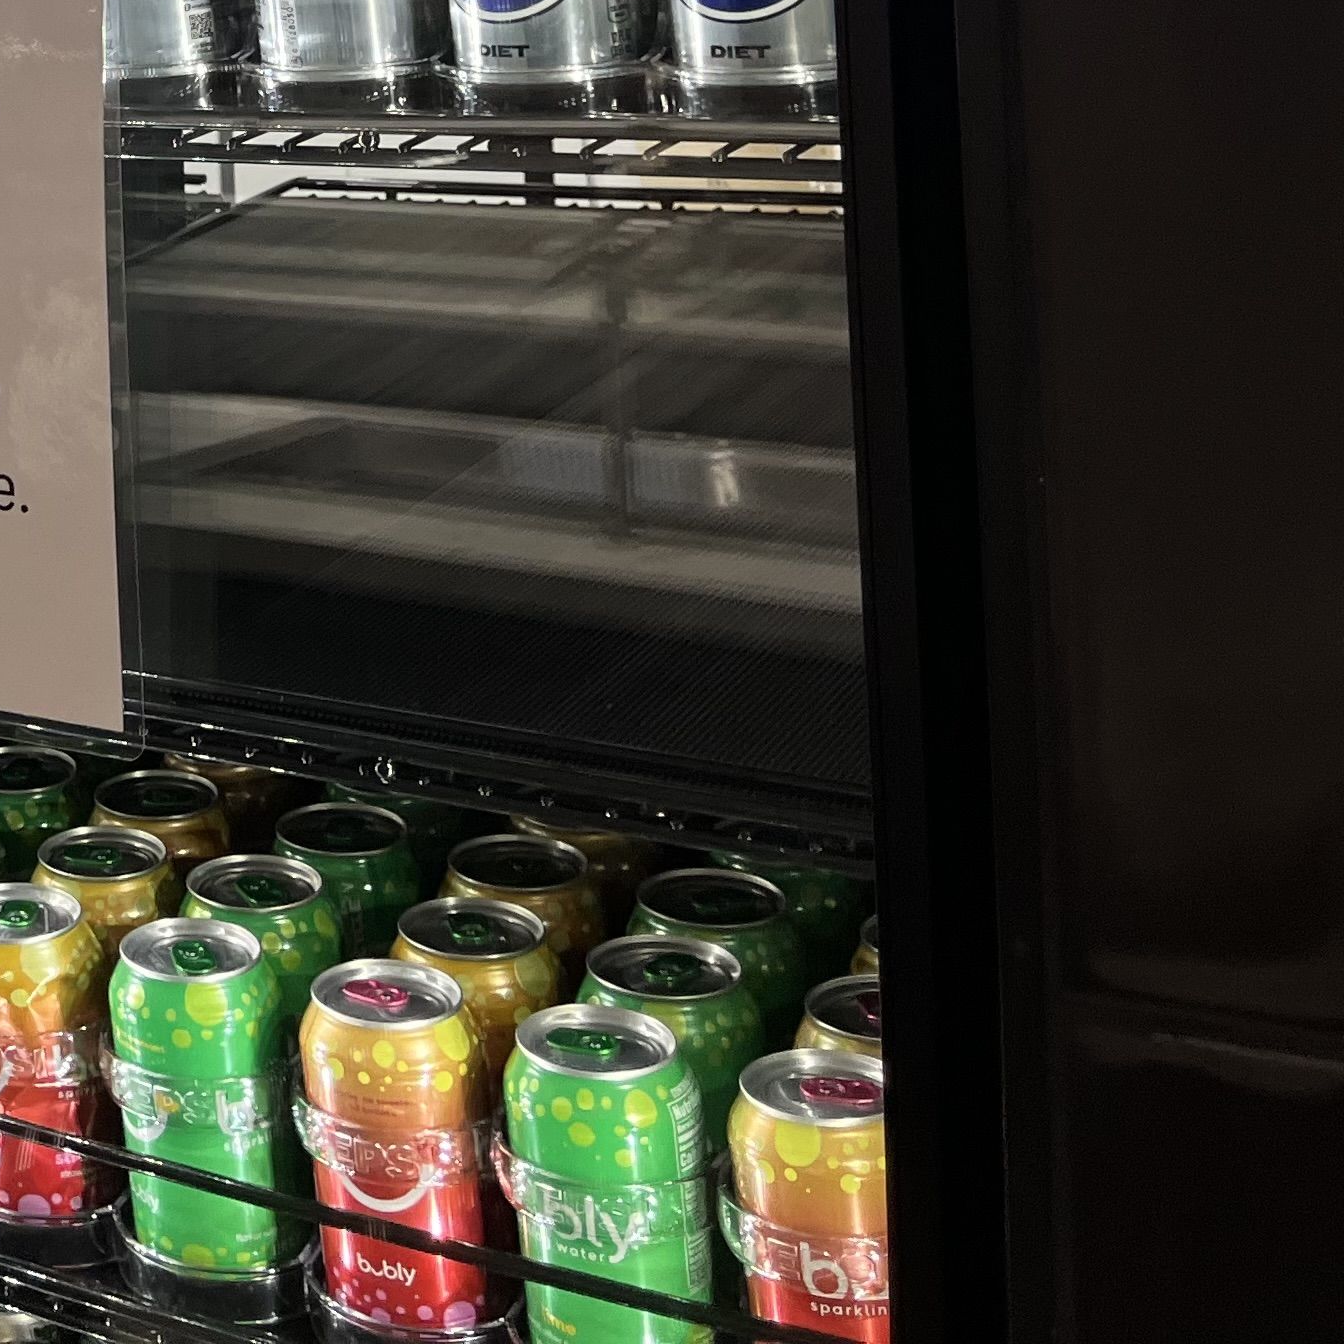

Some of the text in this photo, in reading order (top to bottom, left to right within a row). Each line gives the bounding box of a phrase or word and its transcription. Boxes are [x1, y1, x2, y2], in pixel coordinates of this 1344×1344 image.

[481, 44, 531, 58] DIET
[709, 44, 772, 59] DIET
[556, 1243, 604, 1263] water
[356, 1251, 417, 1286] bubly
[810, 1300, 887, 1318] sparklin
